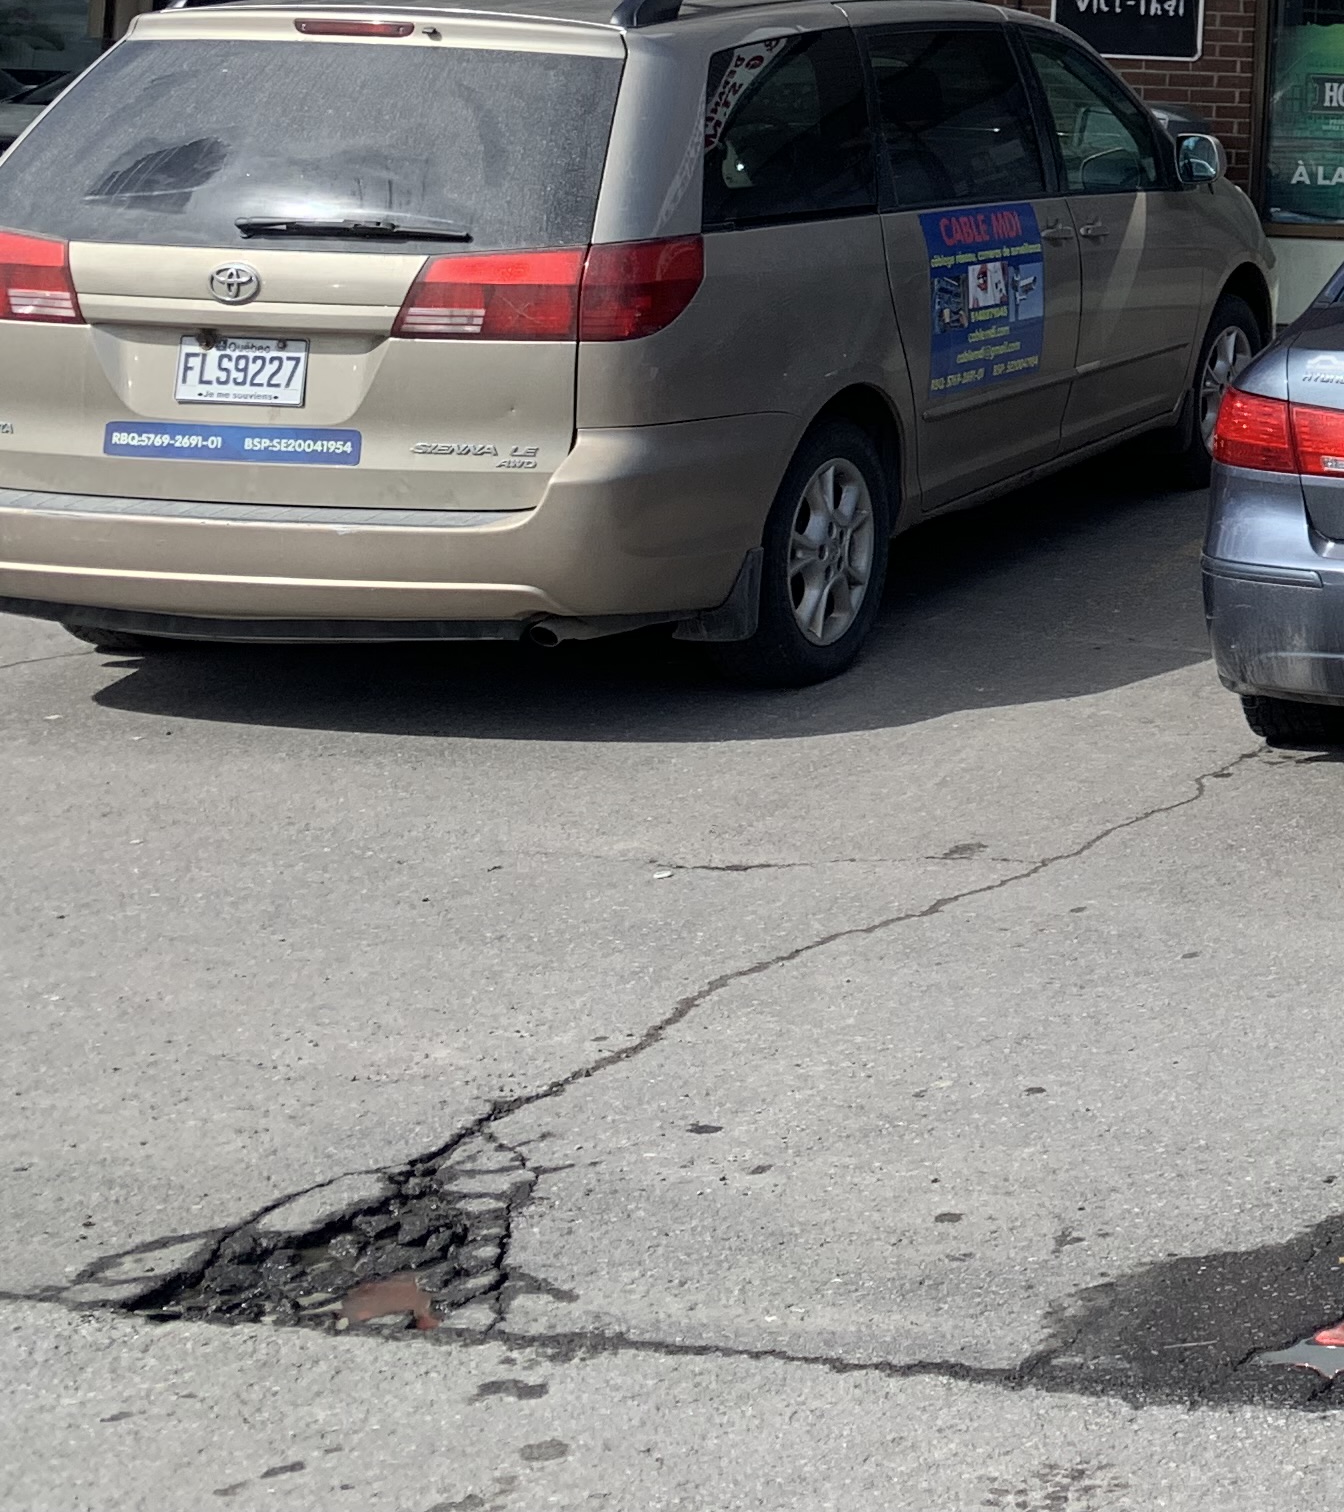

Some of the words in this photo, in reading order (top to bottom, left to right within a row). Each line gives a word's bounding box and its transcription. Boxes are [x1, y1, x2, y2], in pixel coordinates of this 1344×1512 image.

[1290, 161, 1310, 185] À
[939, 214, 990, 246] CABLE
[228, 342, 271, 353] Québec
[182, 353, 301, 388] FLS9227
[233, 392, 273, 401] souviens
[409, 442, 498, 456] SIENNA
[511, 445, 539, 457] LE
[496, 459, 537, 468] AWD
